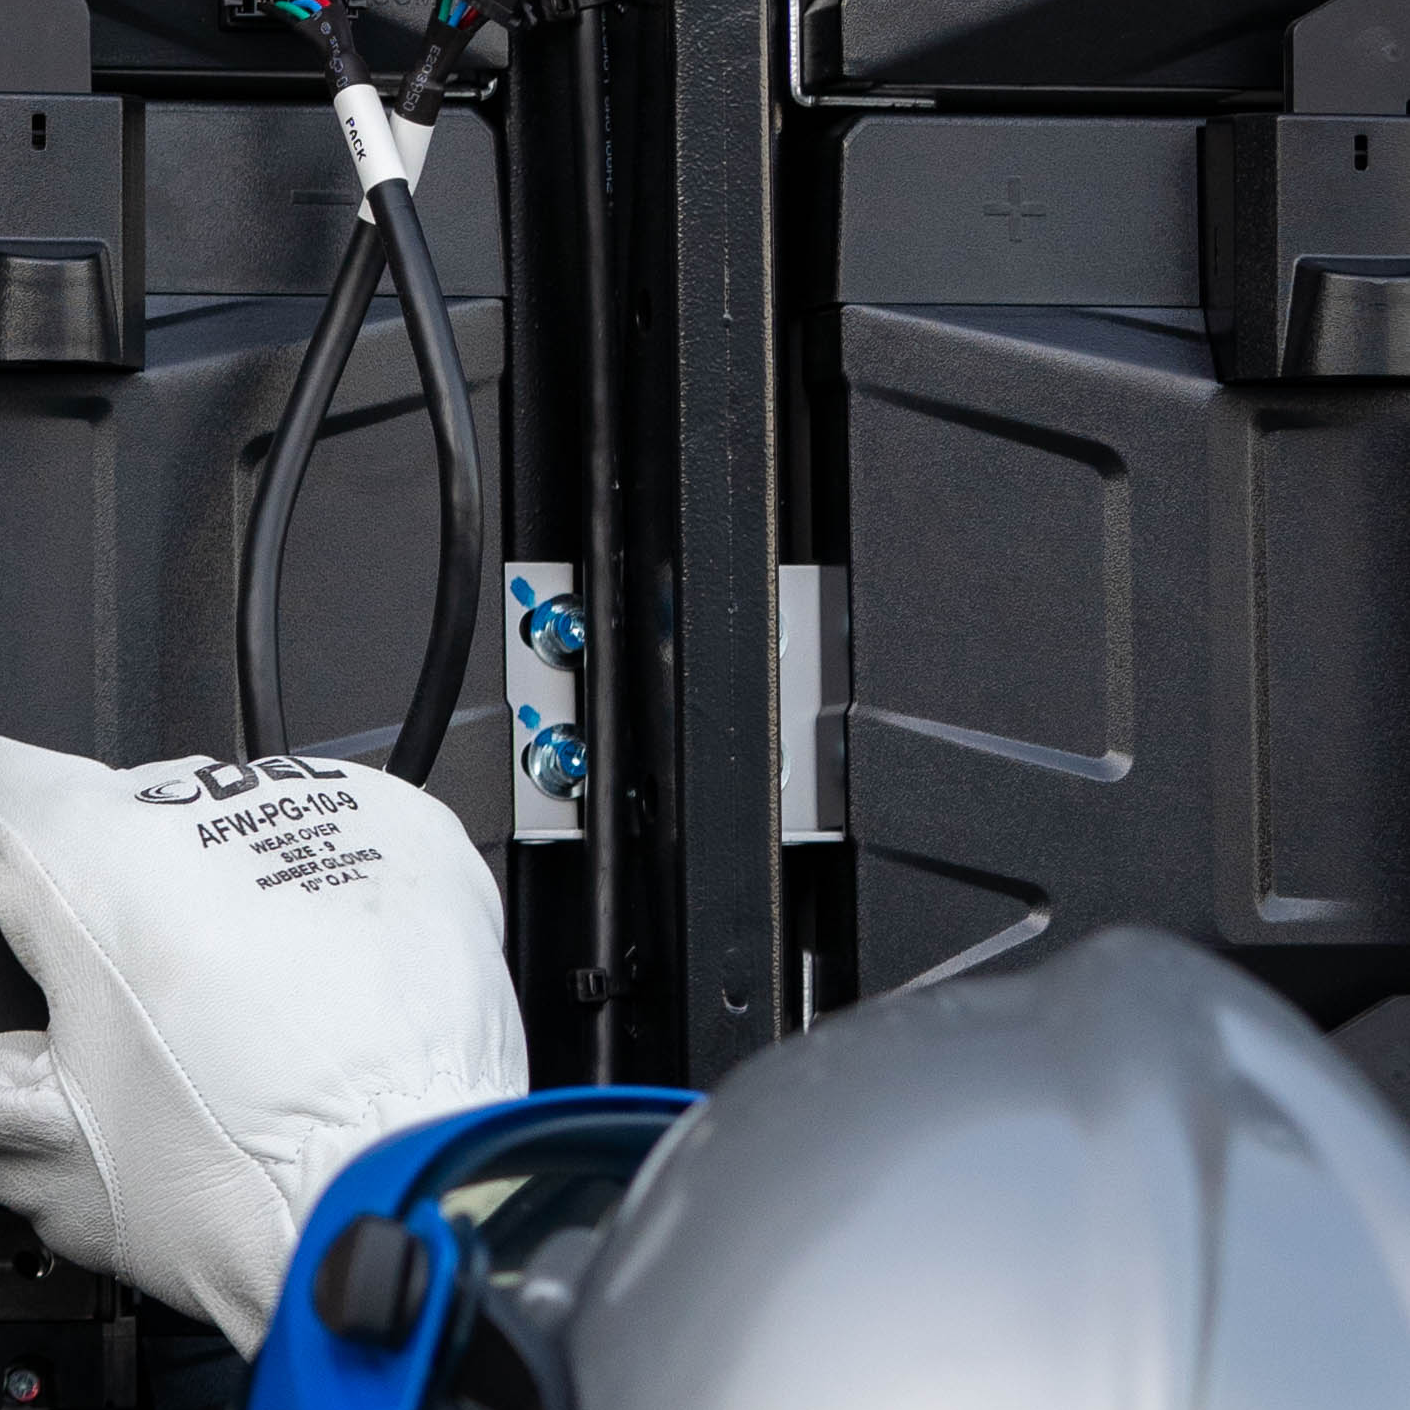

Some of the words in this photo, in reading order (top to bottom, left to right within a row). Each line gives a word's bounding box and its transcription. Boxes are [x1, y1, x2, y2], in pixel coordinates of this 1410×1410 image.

[345, 117, 367, 162] PACK
[197, 790, 358, 848] AFW-PG-10-9
[249, 833, 296, 854] WEAR
[298, 822, 341, 840] OVER
[256, 861, 321, 890] RUBBER
[321, 848, 383, 870] GLOVES
[281, 846, 316, 863] SIZE
[326, 841, 336, 852] 9
